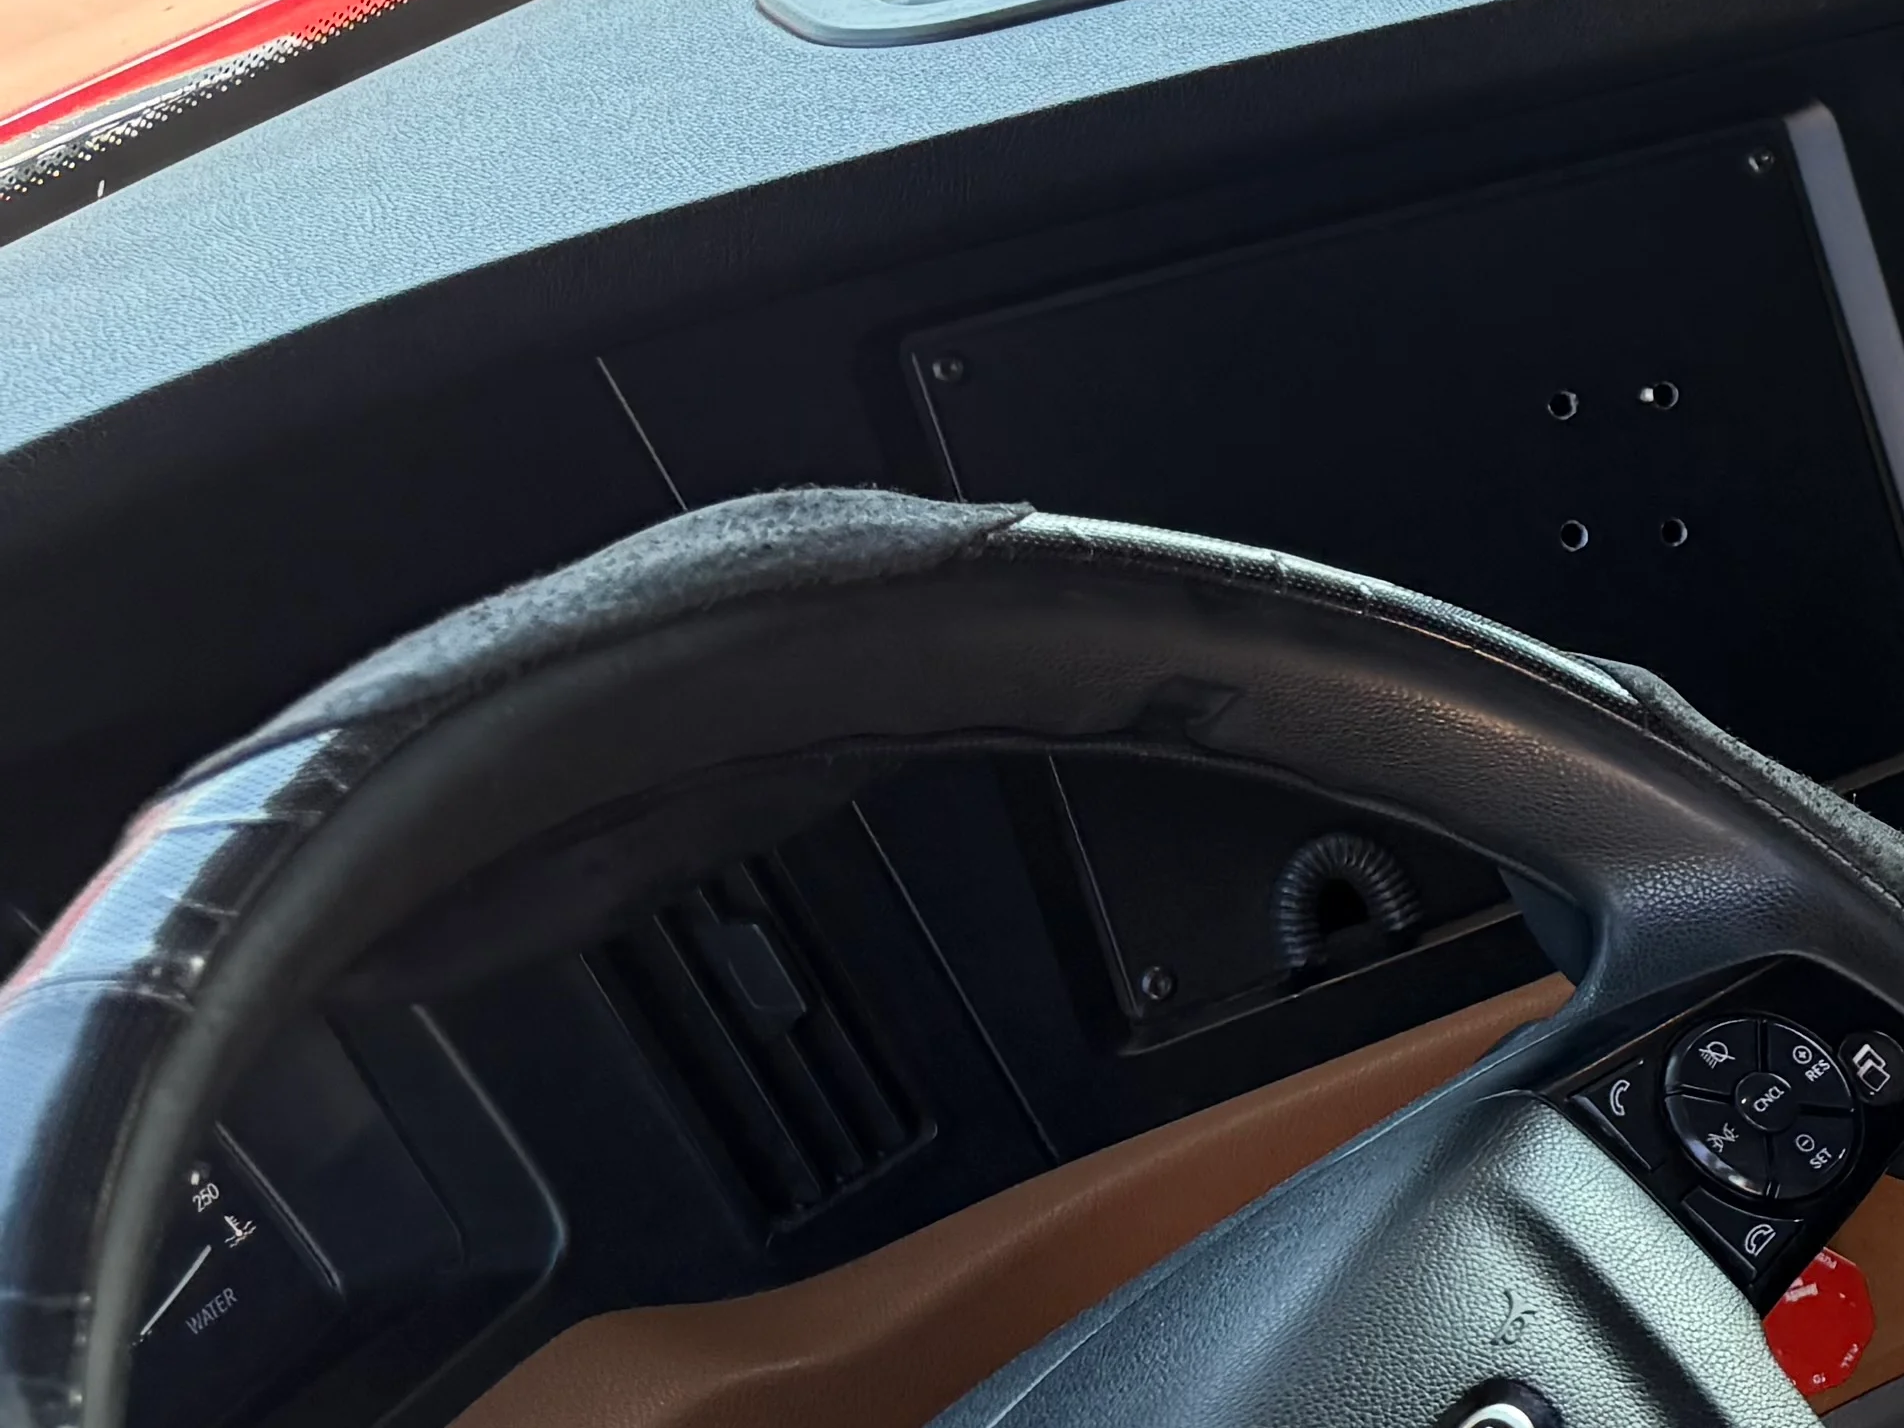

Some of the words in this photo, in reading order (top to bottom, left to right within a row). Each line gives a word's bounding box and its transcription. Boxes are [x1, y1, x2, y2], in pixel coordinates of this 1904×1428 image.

[1804, 1058, 1831, 1083] RES
[1753, 1085, 1785, 1113] CNCL
[1809, 1146, 1833, 1169] SET
[191, 1182, 220, 1213] 250
[185, 1286, 238, 1335] WATER
